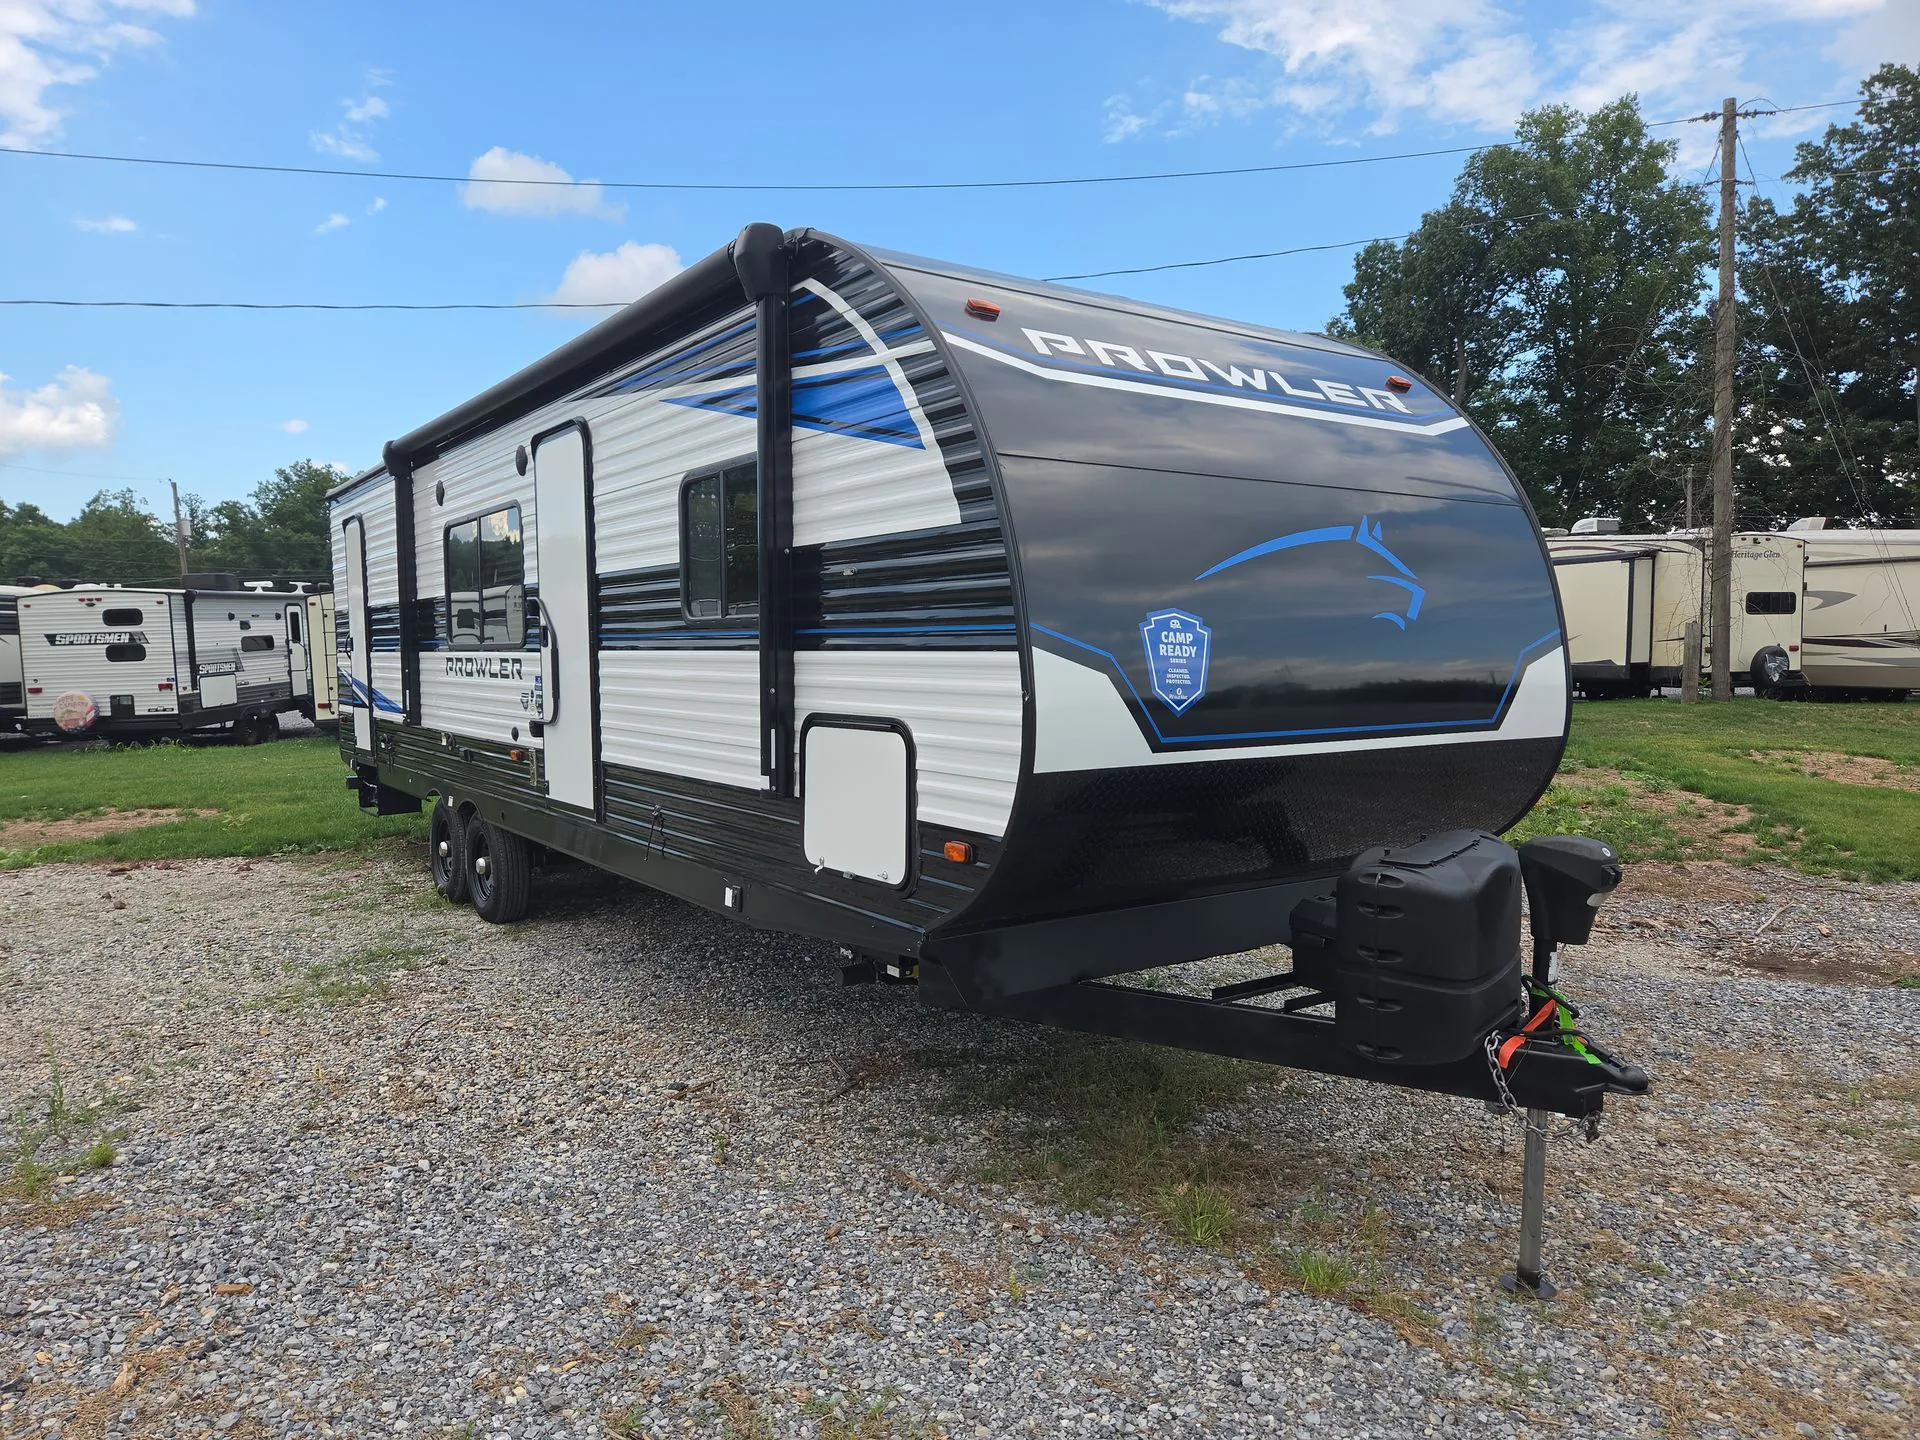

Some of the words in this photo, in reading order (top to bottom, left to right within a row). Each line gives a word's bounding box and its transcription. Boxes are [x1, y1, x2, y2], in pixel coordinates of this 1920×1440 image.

[1021, 327, 1413, 415] PROWLER
[1730, 550, 1762, 560] Heritage
[1763, 550, 1781, 559] Glen
[55, 632, 130, 645] SPORTSMEN
[1161, 631, 1193, 645] CAMP
[1159, 644, 1197, 658] READY
[199, 662, 236, 674] SPORTSMEN
[445, 657, 523, 680] PROWLER
